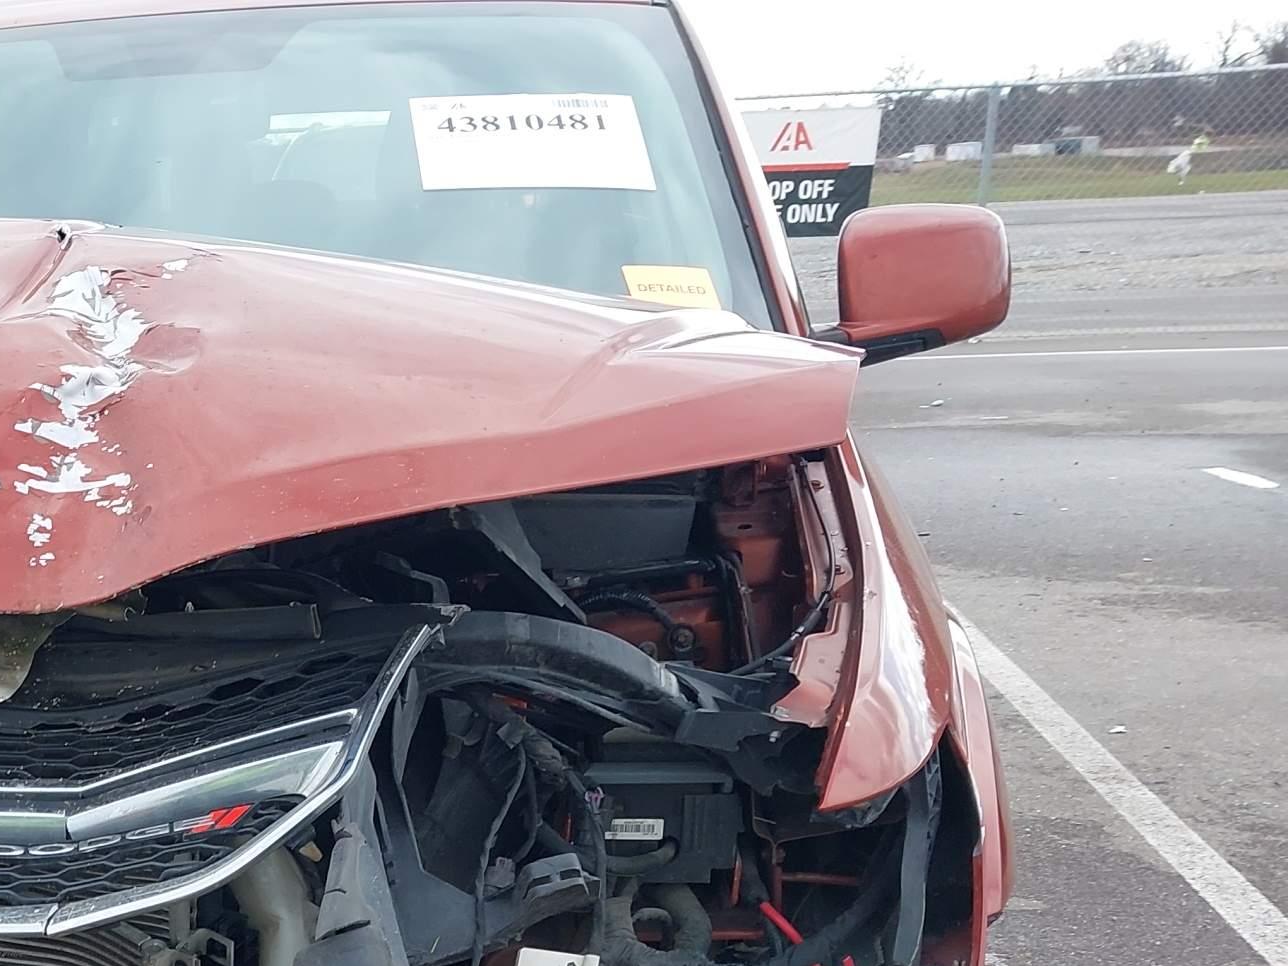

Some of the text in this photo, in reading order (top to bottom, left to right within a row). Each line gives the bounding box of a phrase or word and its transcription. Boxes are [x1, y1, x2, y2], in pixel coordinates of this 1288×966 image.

[437, 113, 607, 133] 43810481
[768, 179, 835, 200] OP OFF
[786, 203, 840, 223] ONLY
[636, 283, 707, 295] DETAILED
